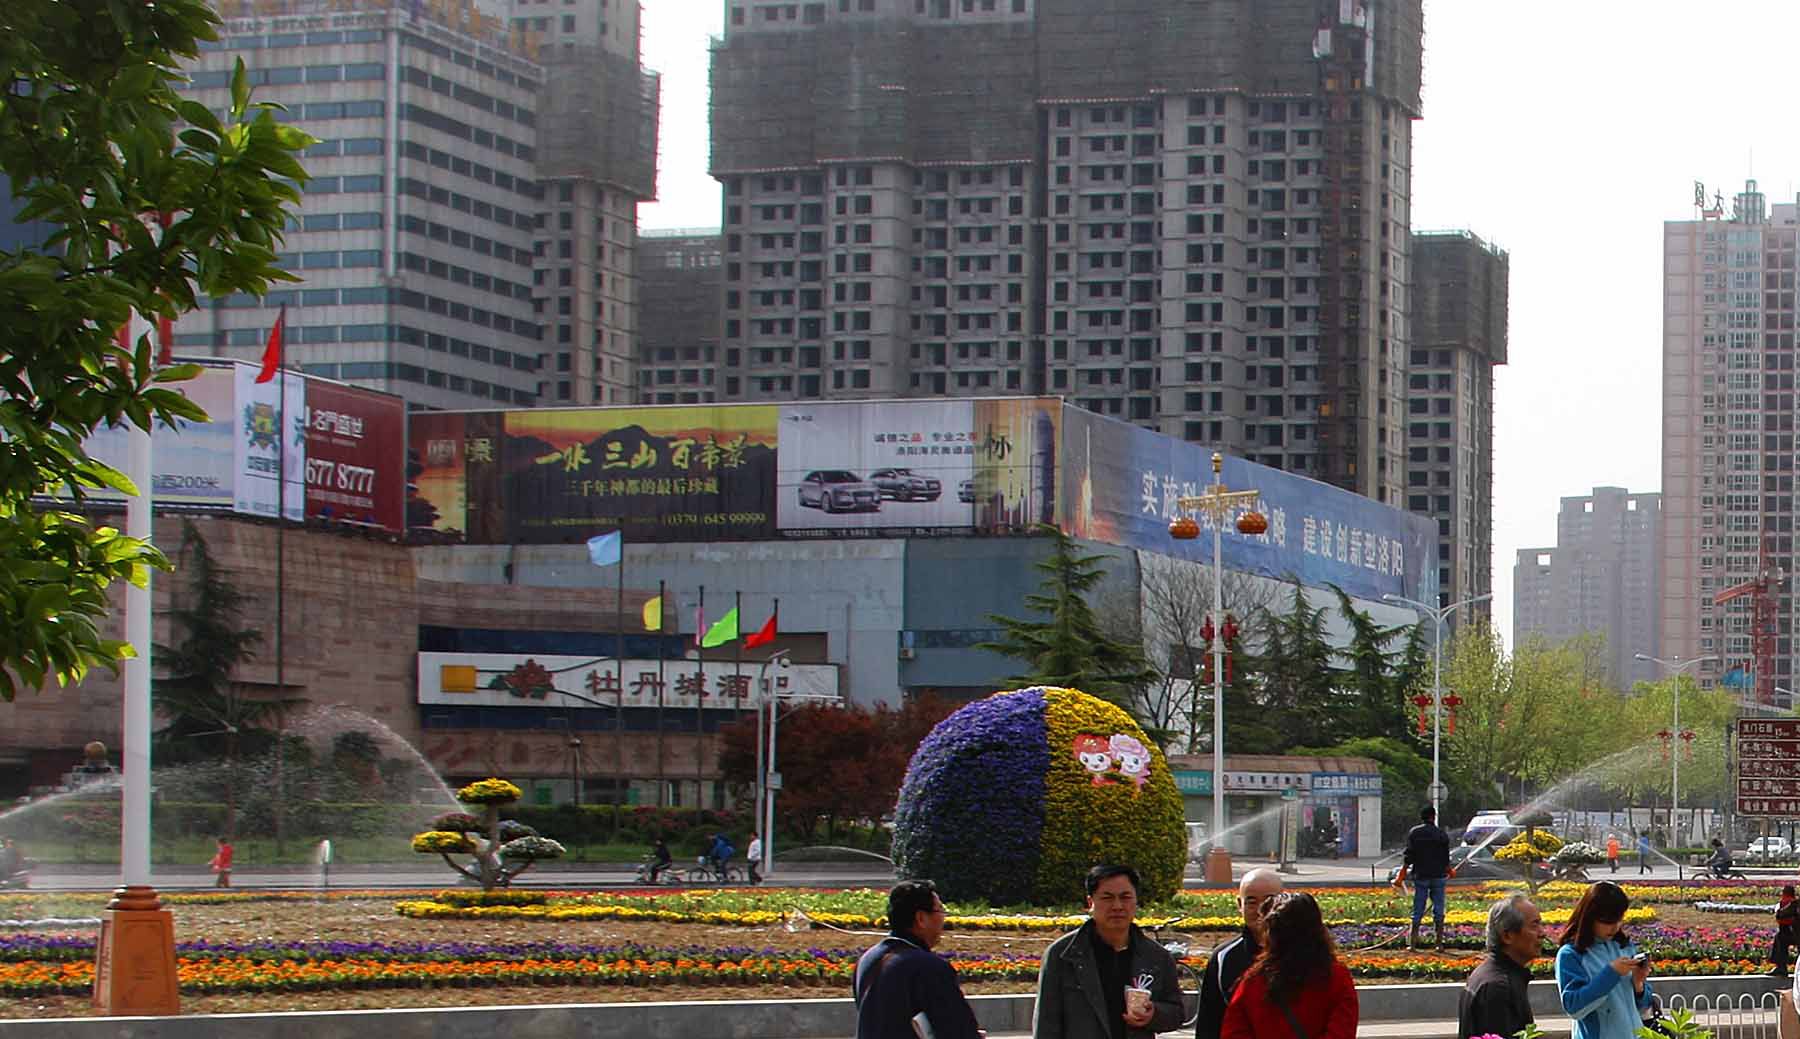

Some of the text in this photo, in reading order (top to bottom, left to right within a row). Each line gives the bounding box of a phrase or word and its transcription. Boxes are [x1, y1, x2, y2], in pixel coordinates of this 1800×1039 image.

[337, 463, 376, 493] 8777
[1302, 514, 1404, 577] 建设创新型洛阳
